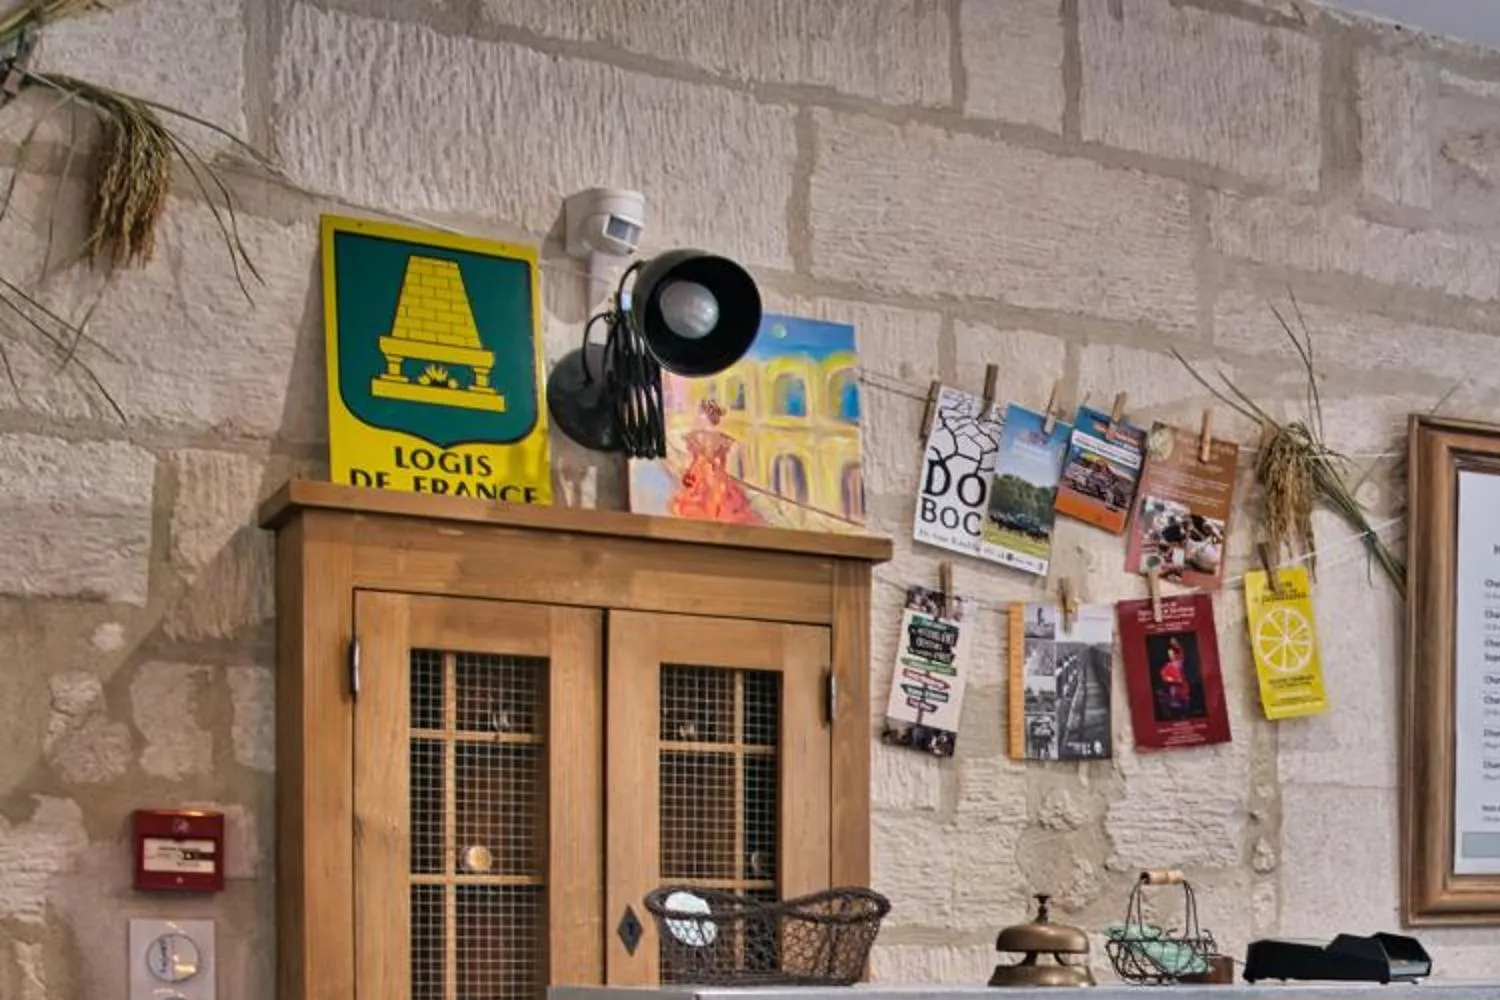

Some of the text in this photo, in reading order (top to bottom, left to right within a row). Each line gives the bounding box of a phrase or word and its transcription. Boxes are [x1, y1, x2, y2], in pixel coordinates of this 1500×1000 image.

[393, 446, 493, 477] LOGIS
[350, 468, 540, 504] DE FRANCE
